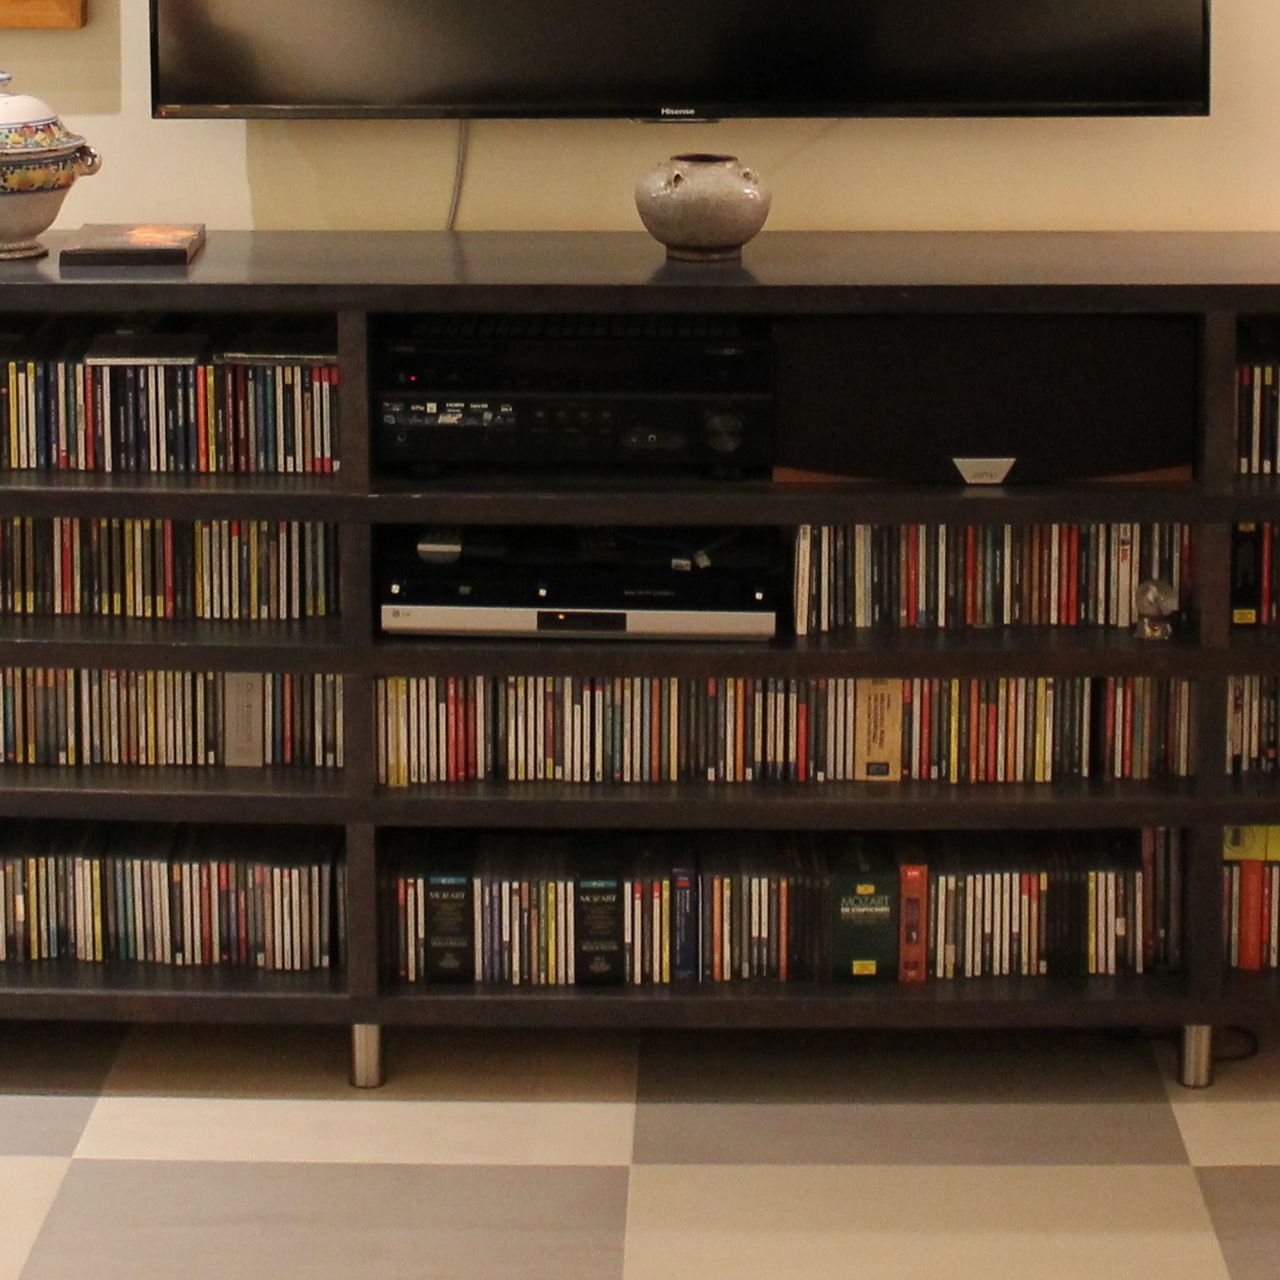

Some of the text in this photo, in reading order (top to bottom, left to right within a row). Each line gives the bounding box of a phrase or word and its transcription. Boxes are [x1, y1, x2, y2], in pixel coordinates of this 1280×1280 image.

[661, 107, 695, 115] Hisense
[430, 891, 465, 899] MOZART
[580, 895, 617, 903] MOZART
[841, 896, 889, 907] MOZART
